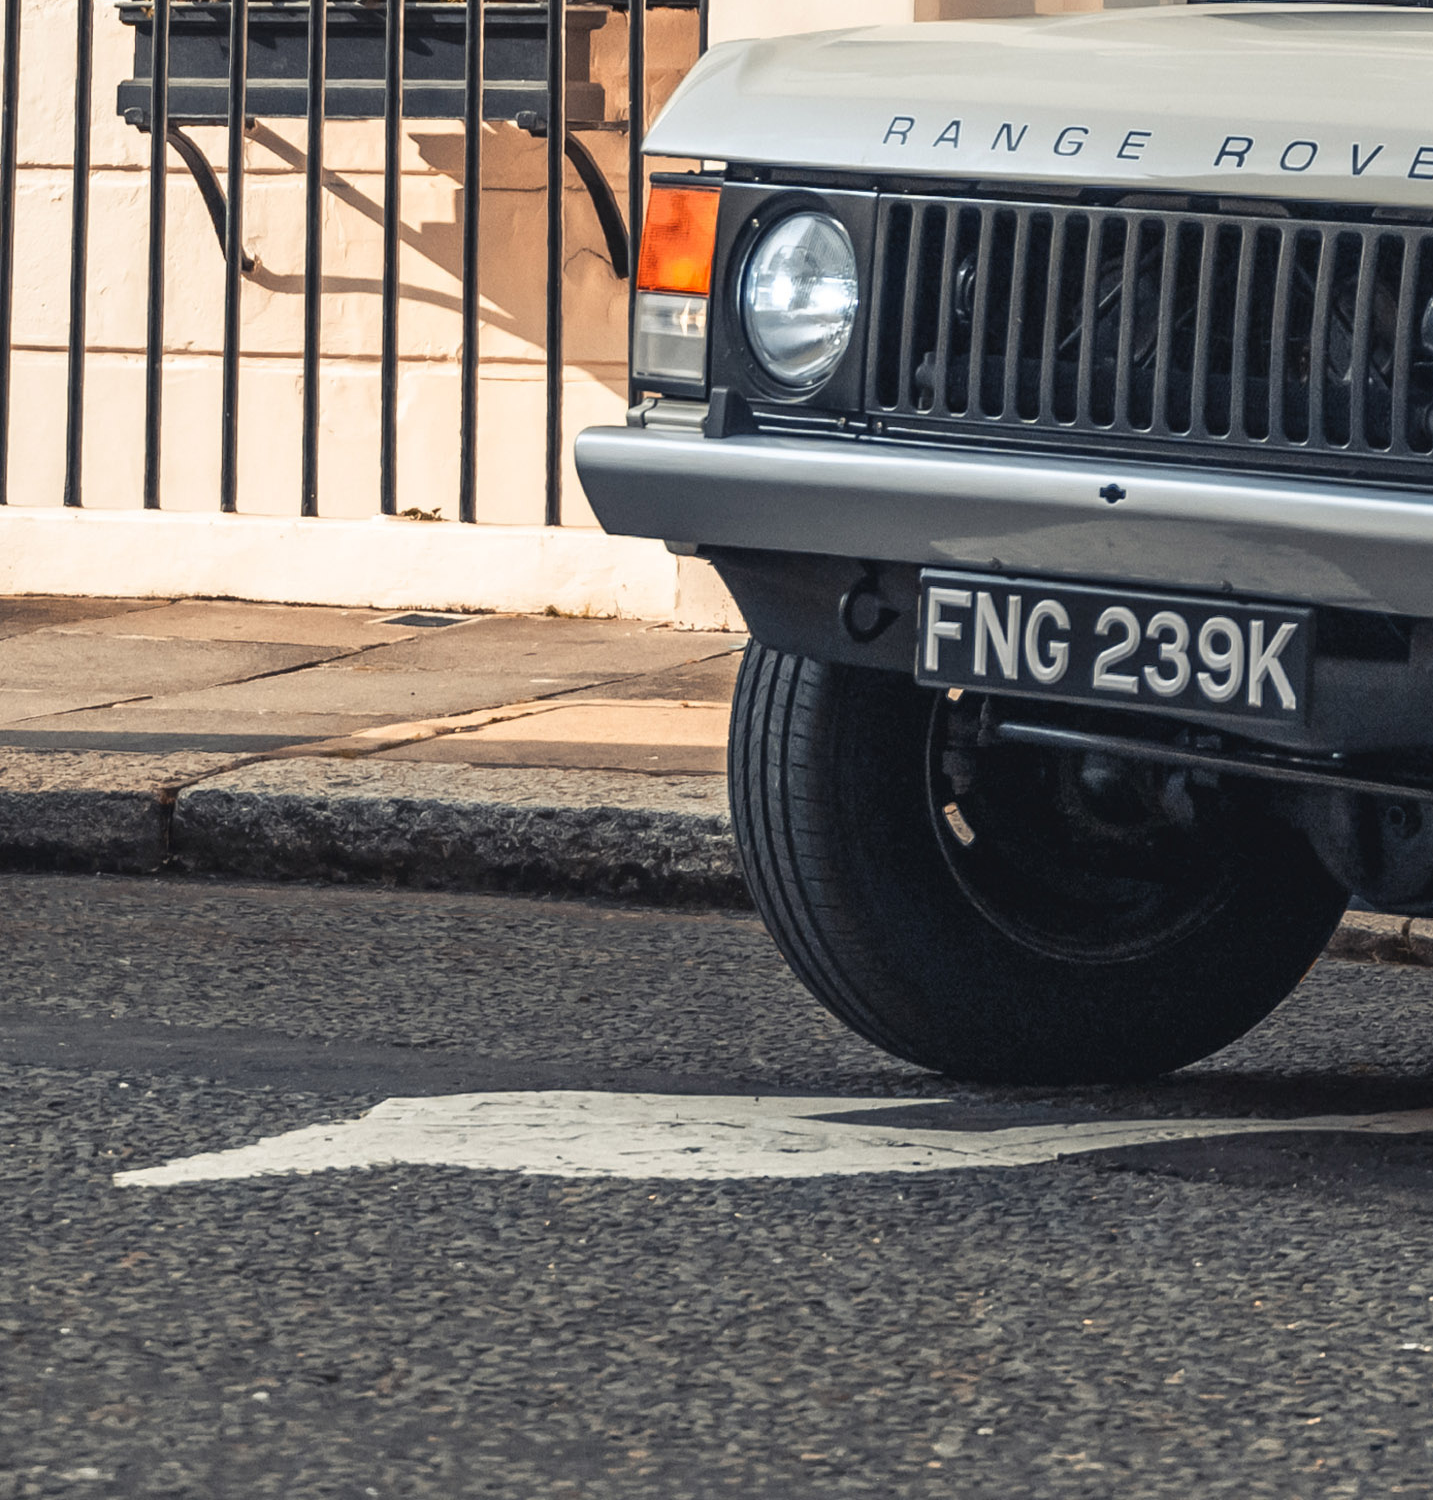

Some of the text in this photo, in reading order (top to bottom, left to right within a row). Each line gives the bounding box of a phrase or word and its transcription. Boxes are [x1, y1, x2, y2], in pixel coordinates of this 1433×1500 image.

[882, 116, 1152, 160] RANGE
[924, 586, 1298, 711] FNG 239K
